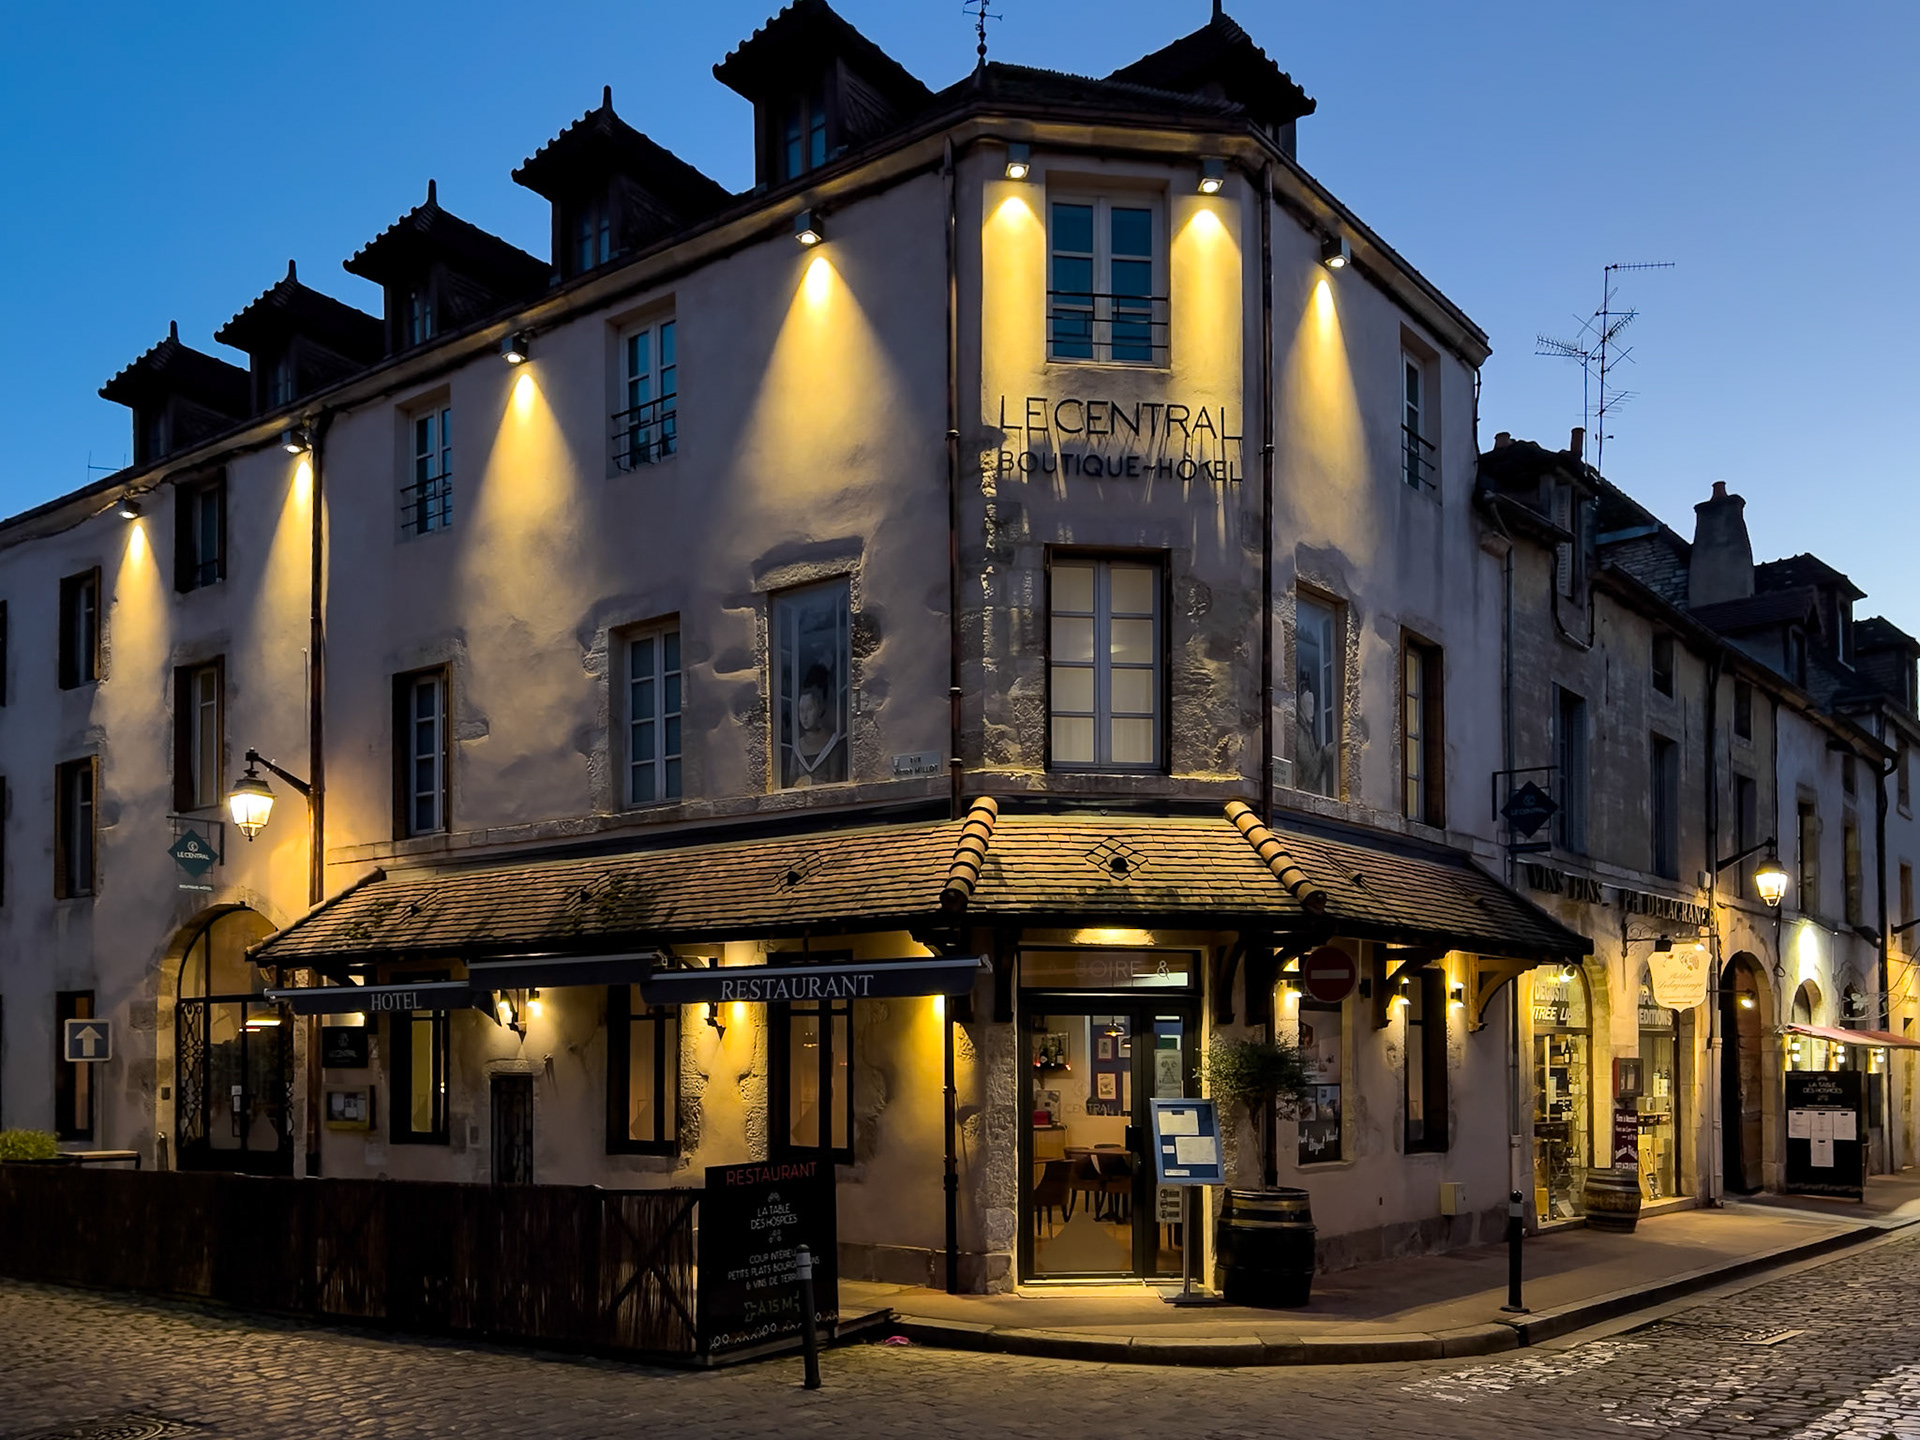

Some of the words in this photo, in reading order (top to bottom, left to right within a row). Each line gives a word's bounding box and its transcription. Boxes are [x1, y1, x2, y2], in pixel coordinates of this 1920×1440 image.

[1532, 864, 1564, 894] VINS
[1573, 876, 1603, 906] FINS
[1647, 894, 1715, 929] DELAGRANGE
[1075, 960, 1143, 978] BOIRE
[1156, 959, 1171, 981] &
[720, 974, 874, 1001] RESTAURANT
[370, 991, 423, 1011] HOTEL
[725, 1161, 818, 1187] RESTAURANT
[757, 1206, 768, 1217] LA
[769, 1202, 791, 1215] TABLE
[750, 1219, 765, 1230] DES
[765, 1213, 798, 1227] HOSPICES
[727, 1267, 749, 1281] PETITS
[751, 1264, 771, 1277] PLATS
[768, 1276, 779, 1287] DE
